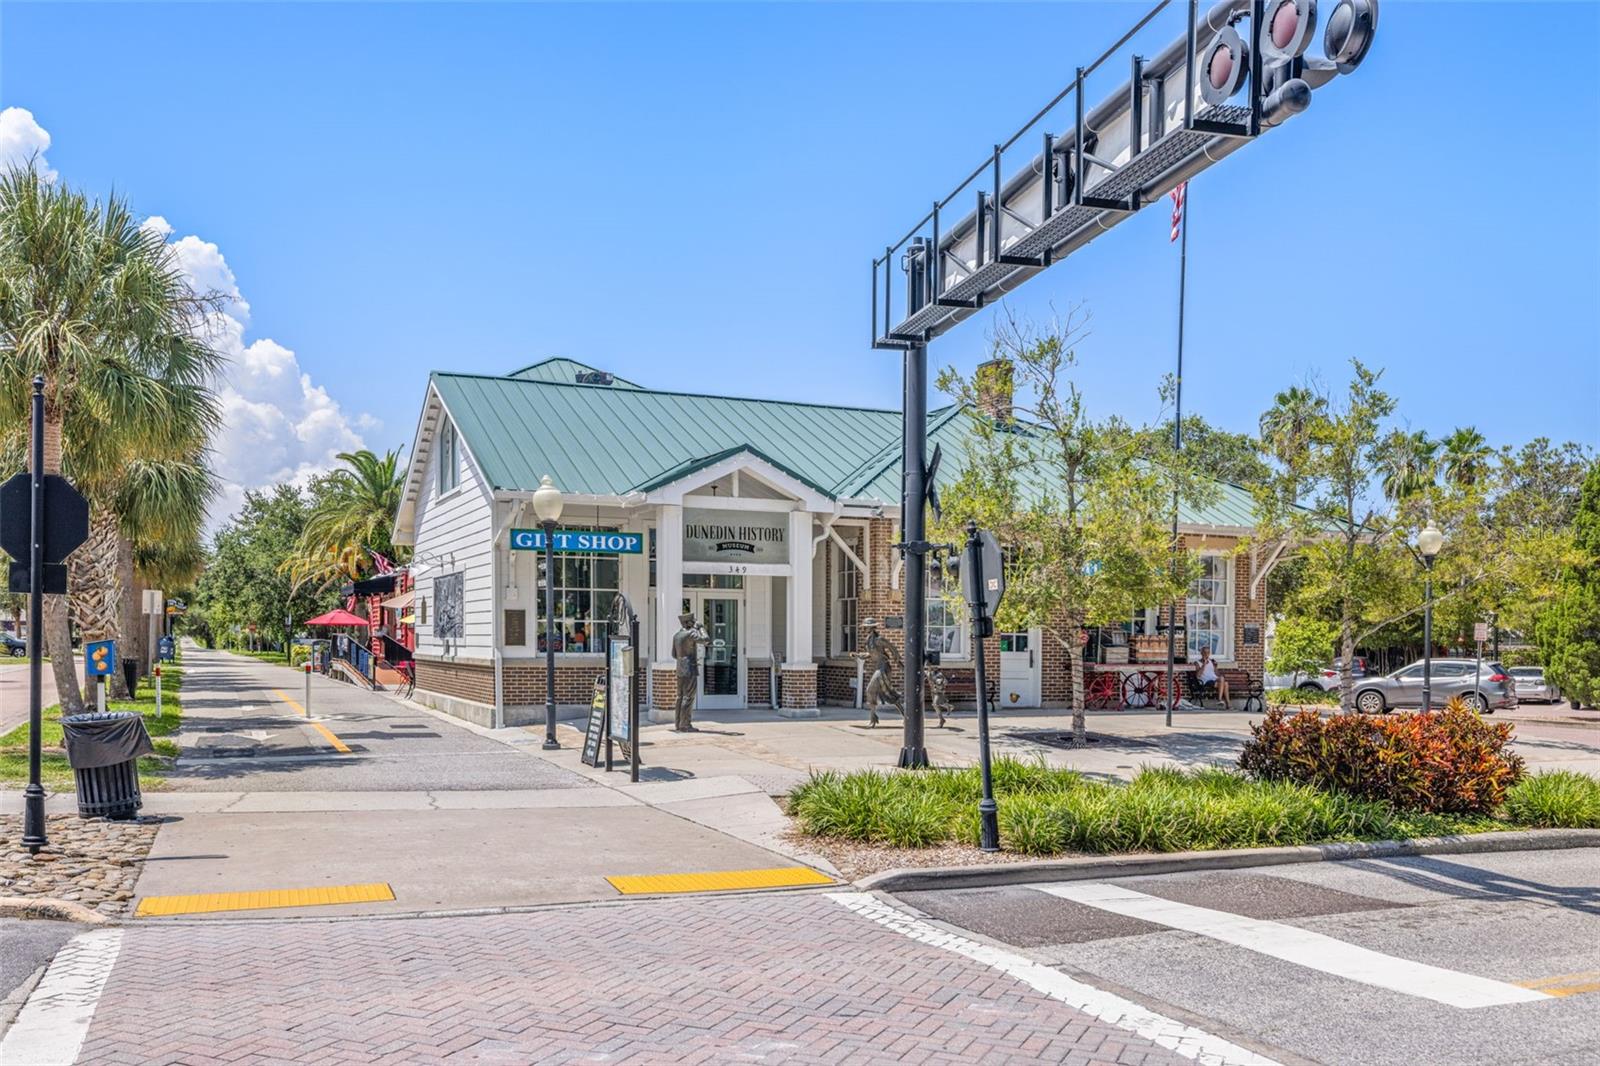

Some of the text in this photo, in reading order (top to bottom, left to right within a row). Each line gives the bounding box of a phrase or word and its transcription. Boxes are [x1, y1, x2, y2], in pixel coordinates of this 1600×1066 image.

[686, 525, 785, 542] DUNEDIN HISTORY
[578, 534, 637, 550] SHOP
[721, 542, 751, 551] MUSEUM
